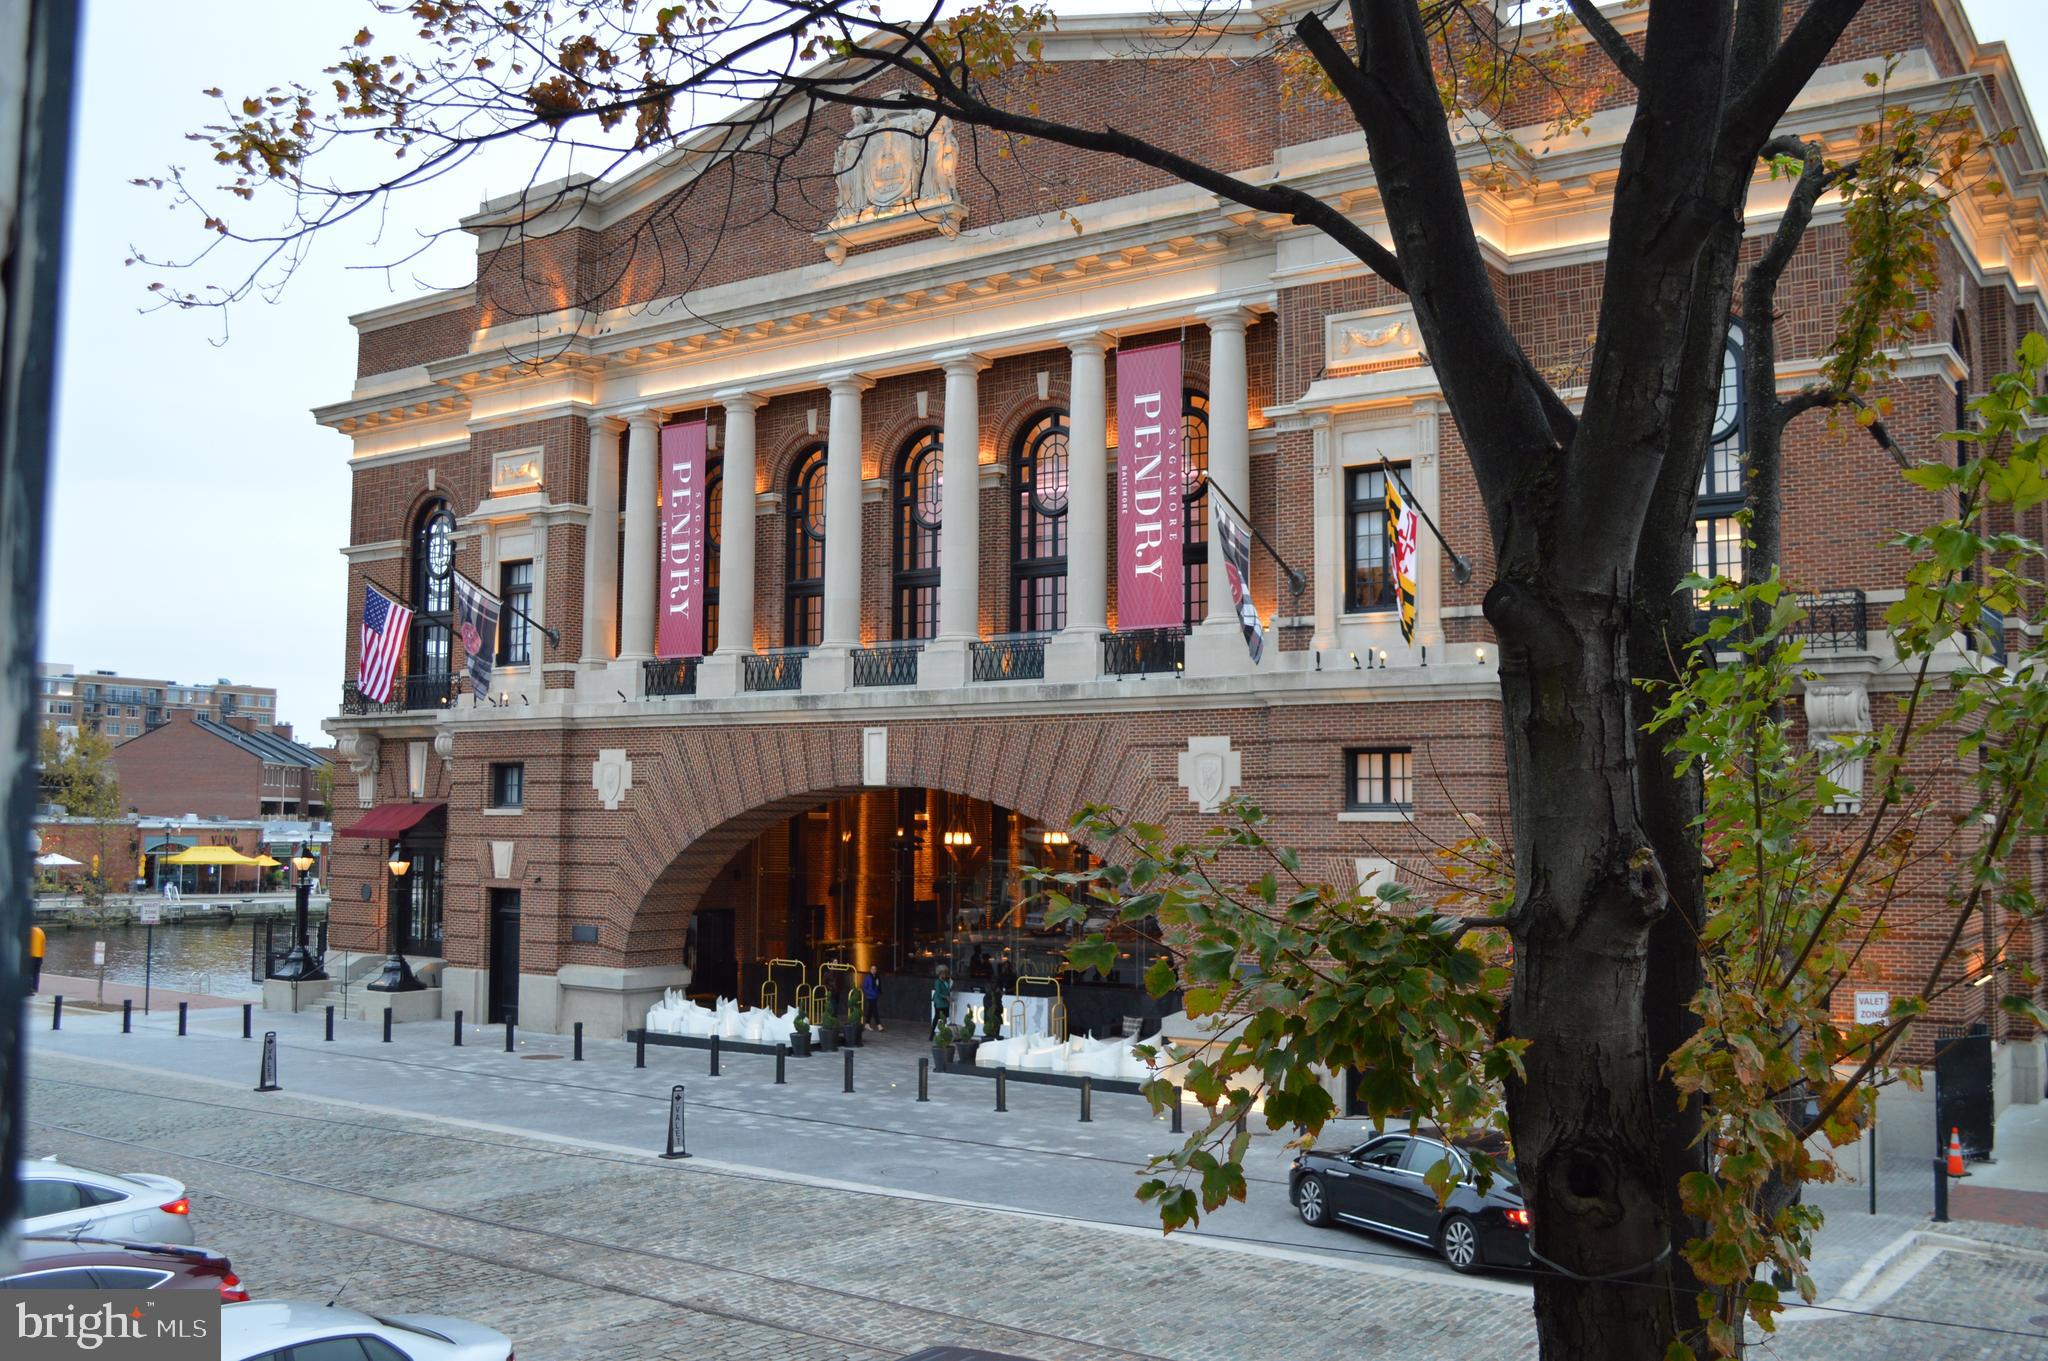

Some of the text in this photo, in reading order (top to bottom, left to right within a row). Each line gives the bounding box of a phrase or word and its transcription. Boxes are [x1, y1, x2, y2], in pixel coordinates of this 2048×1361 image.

[1134, 390, 1163, 582] PENDRY
[1168, 428, 1178, 541] SAGAMORE
[669, 459, 692, 620] PENDRY
[693, 491, 701, 585] SAGAMORE
[210, 834, 238, 846] VINO
[1858, 997, 1884, 1005] VALET
